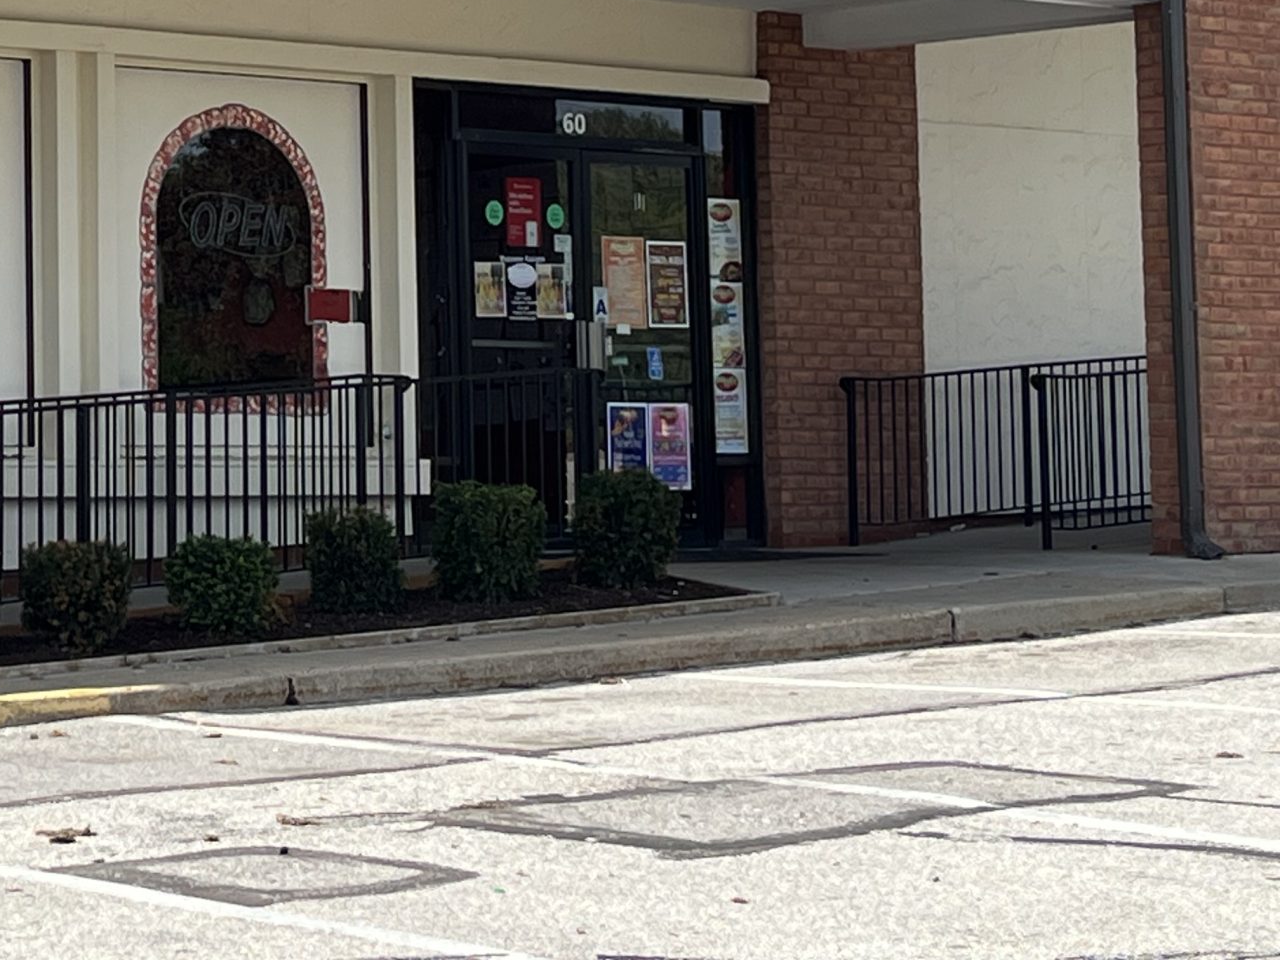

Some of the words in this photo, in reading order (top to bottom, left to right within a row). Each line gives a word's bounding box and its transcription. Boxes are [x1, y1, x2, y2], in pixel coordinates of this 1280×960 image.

[562, 112, 587, 135] 60
[189, 201, 289, 248] OPEN
[595, 298, 608, 316] A
